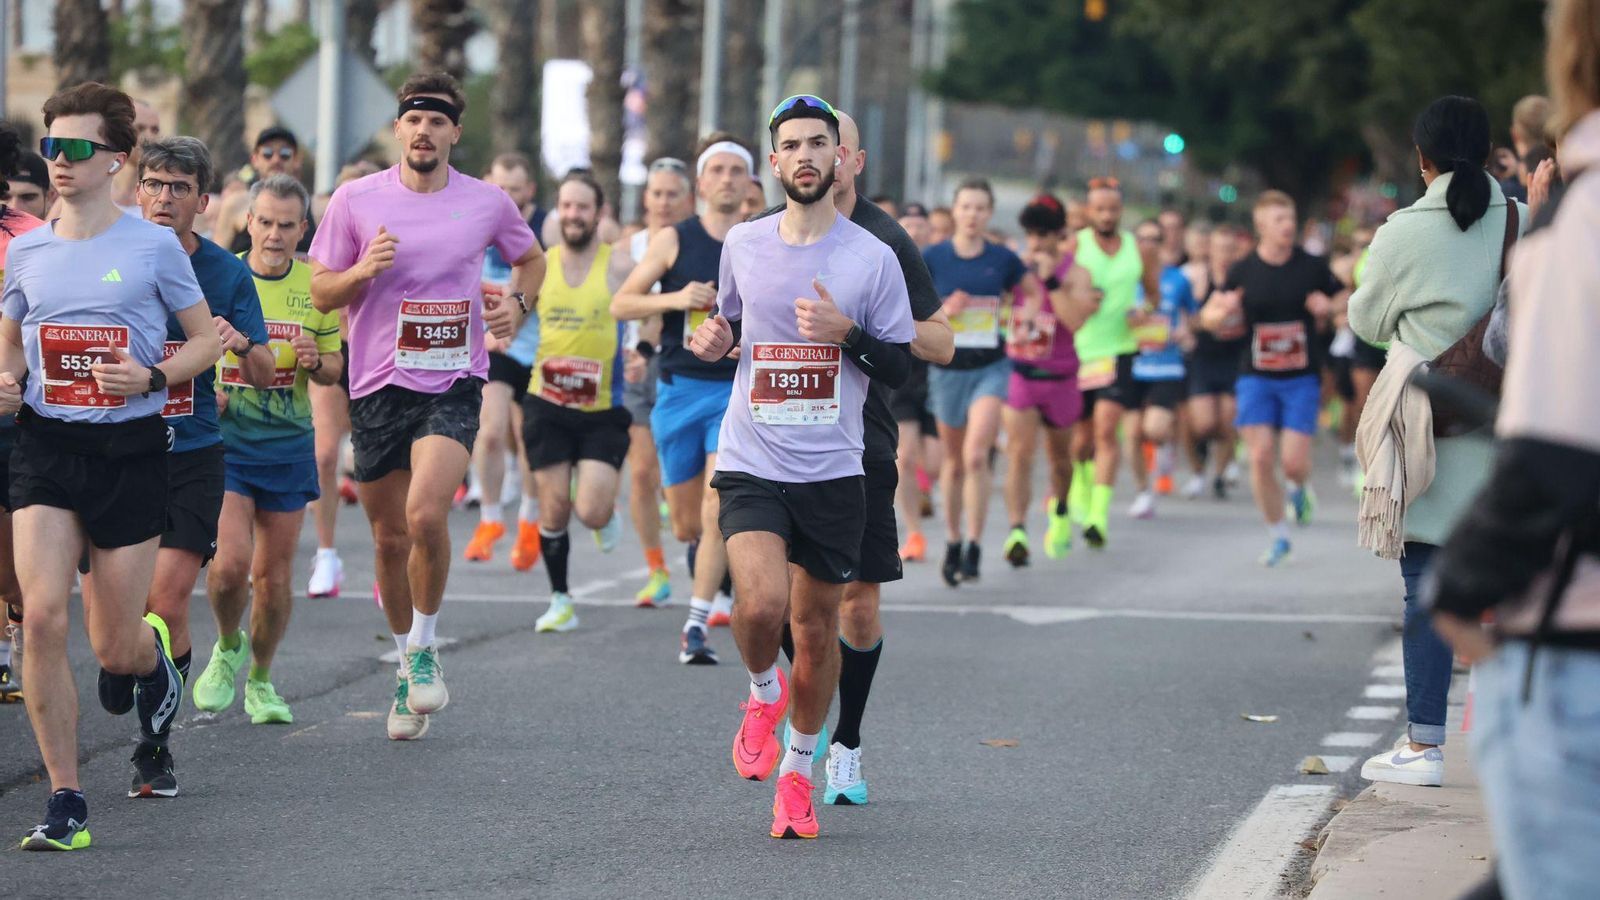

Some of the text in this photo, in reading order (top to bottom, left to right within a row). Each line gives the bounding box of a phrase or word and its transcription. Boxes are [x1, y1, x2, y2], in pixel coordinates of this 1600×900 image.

[421, 303, 466, 315] GENERALI
[60, 329, 122, 342] GENERALI
[415, 325, 459, 339] 13453
[774, 347, 833, 360] GENERALI
[768, 372, 819, 389] 13911
